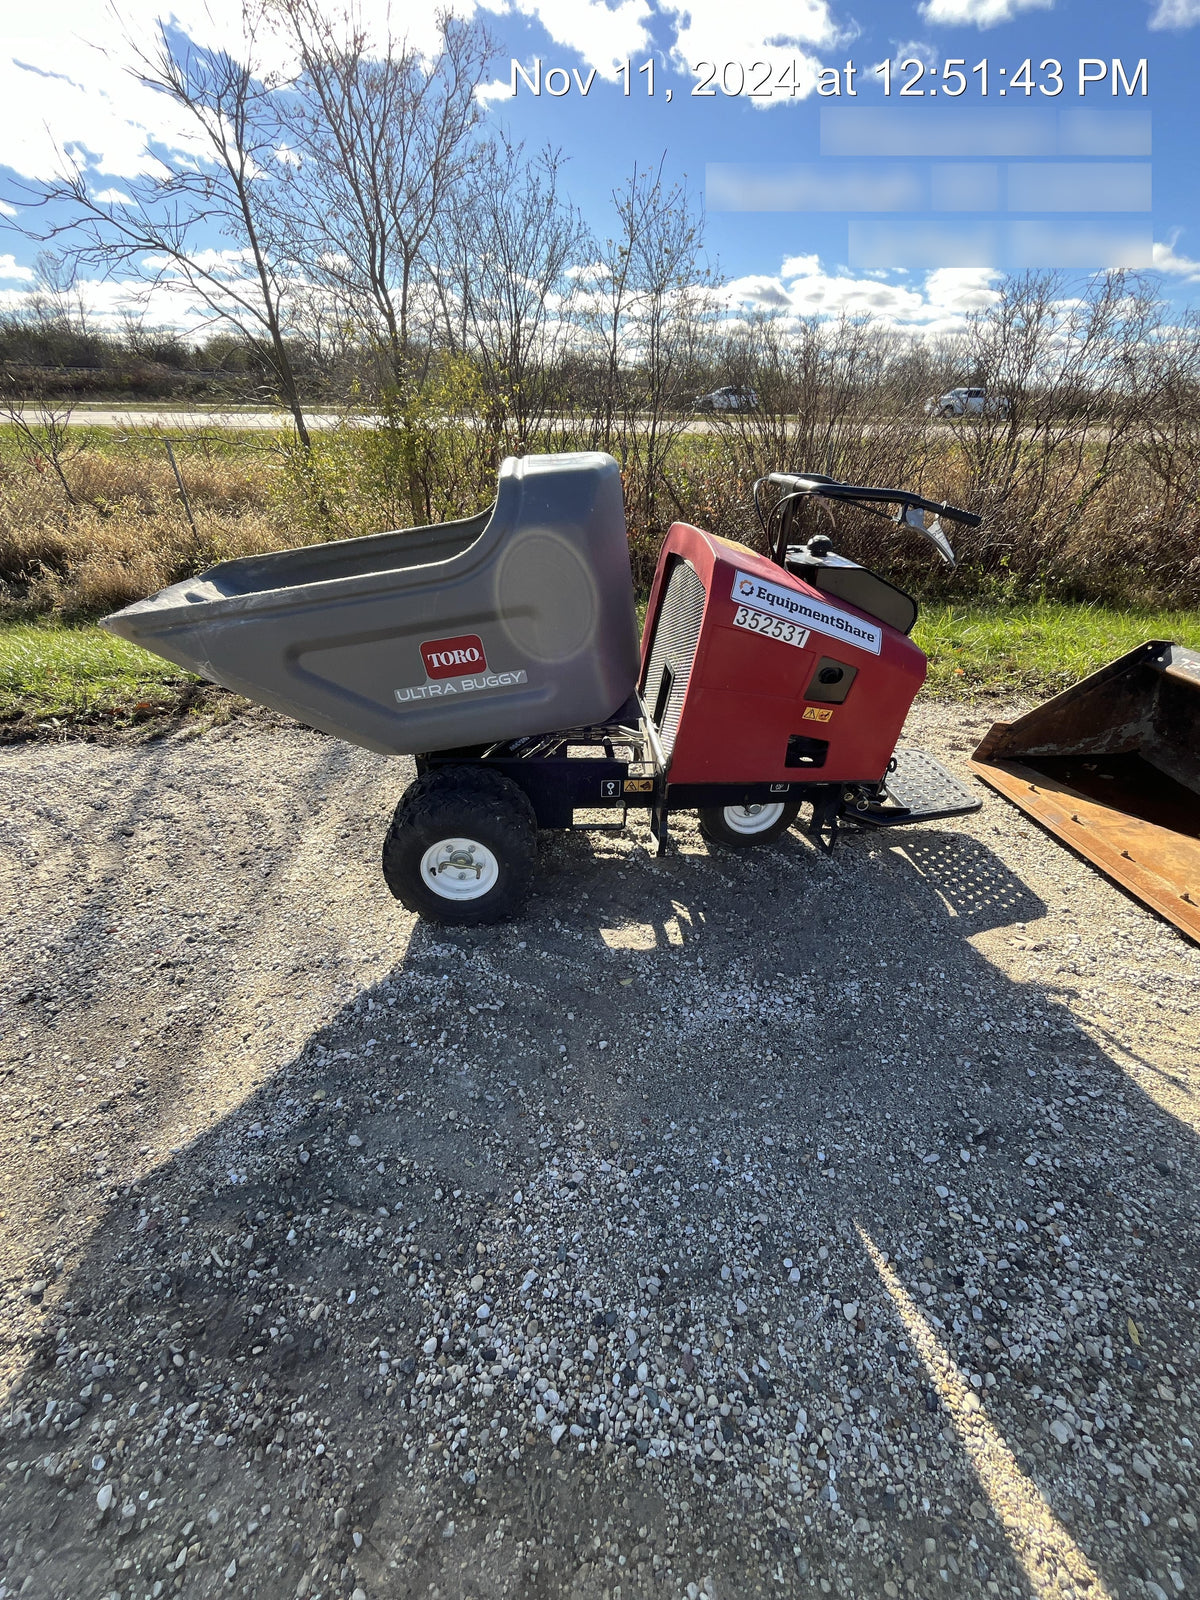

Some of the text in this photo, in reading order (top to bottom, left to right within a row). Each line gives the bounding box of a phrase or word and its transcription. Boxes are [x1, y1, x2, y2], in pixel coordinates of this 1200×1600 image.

[736, 608, 807, 646] 352531
[756, 586, 875, 643] EquipmentShare
[427, 647, 480, 668] TORO
[396, 672, 522, 701] ULTRA BUGGY
